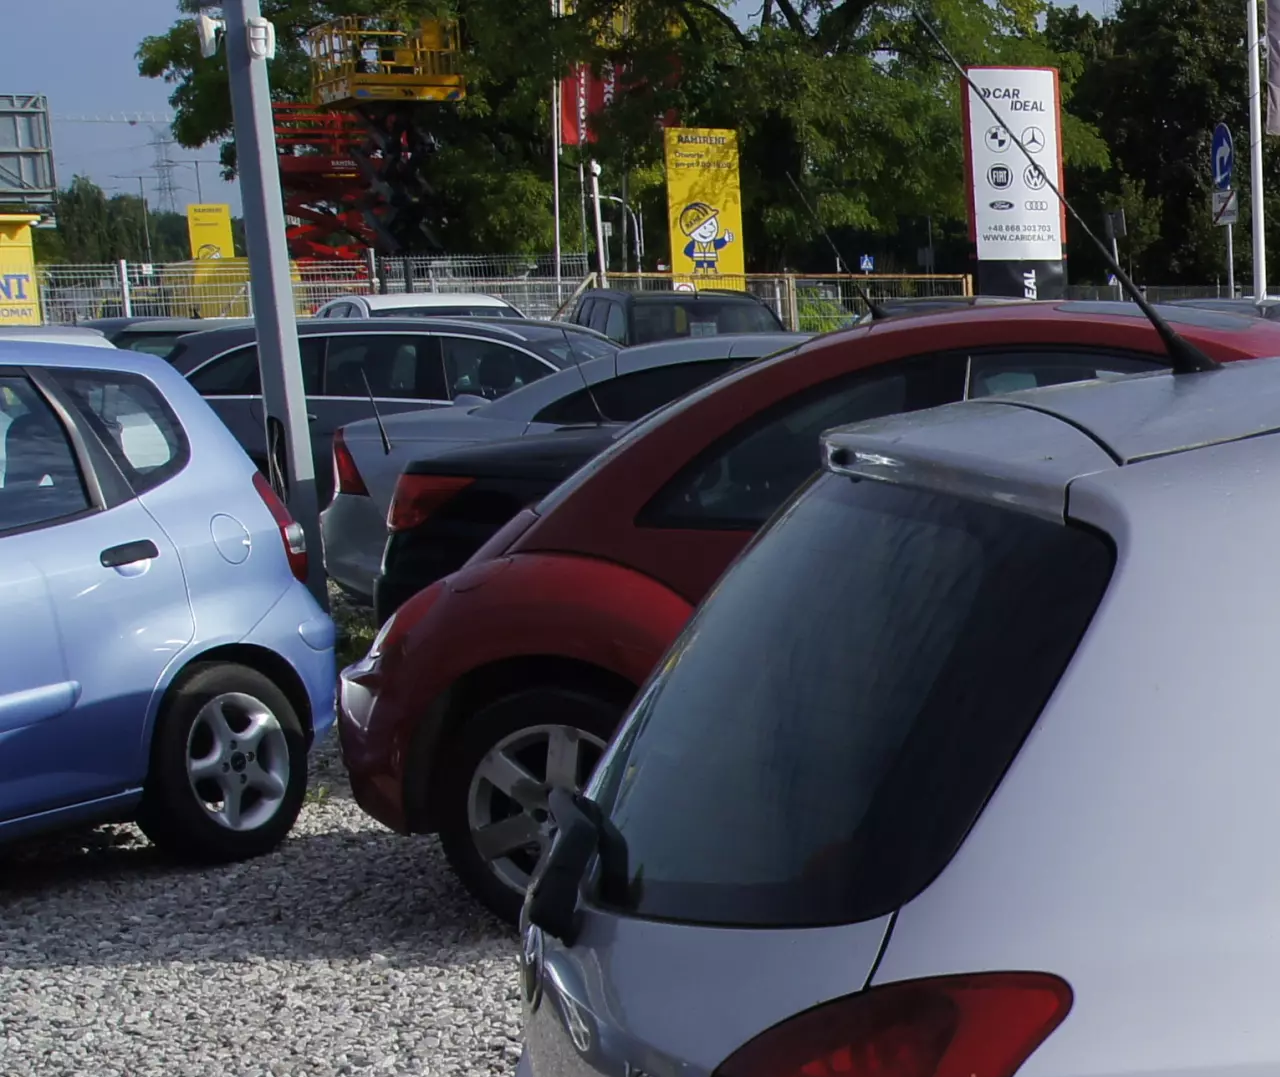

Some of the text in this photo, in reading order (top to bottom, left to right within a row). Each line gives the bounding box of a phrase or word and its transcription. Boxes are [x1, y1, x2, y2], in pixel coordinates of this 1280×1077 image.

[992, 87, 1021, 99] CAR
[1010, 100, 1046, 112] IDEAL
[992, 170, 1008, 183] FIAT
